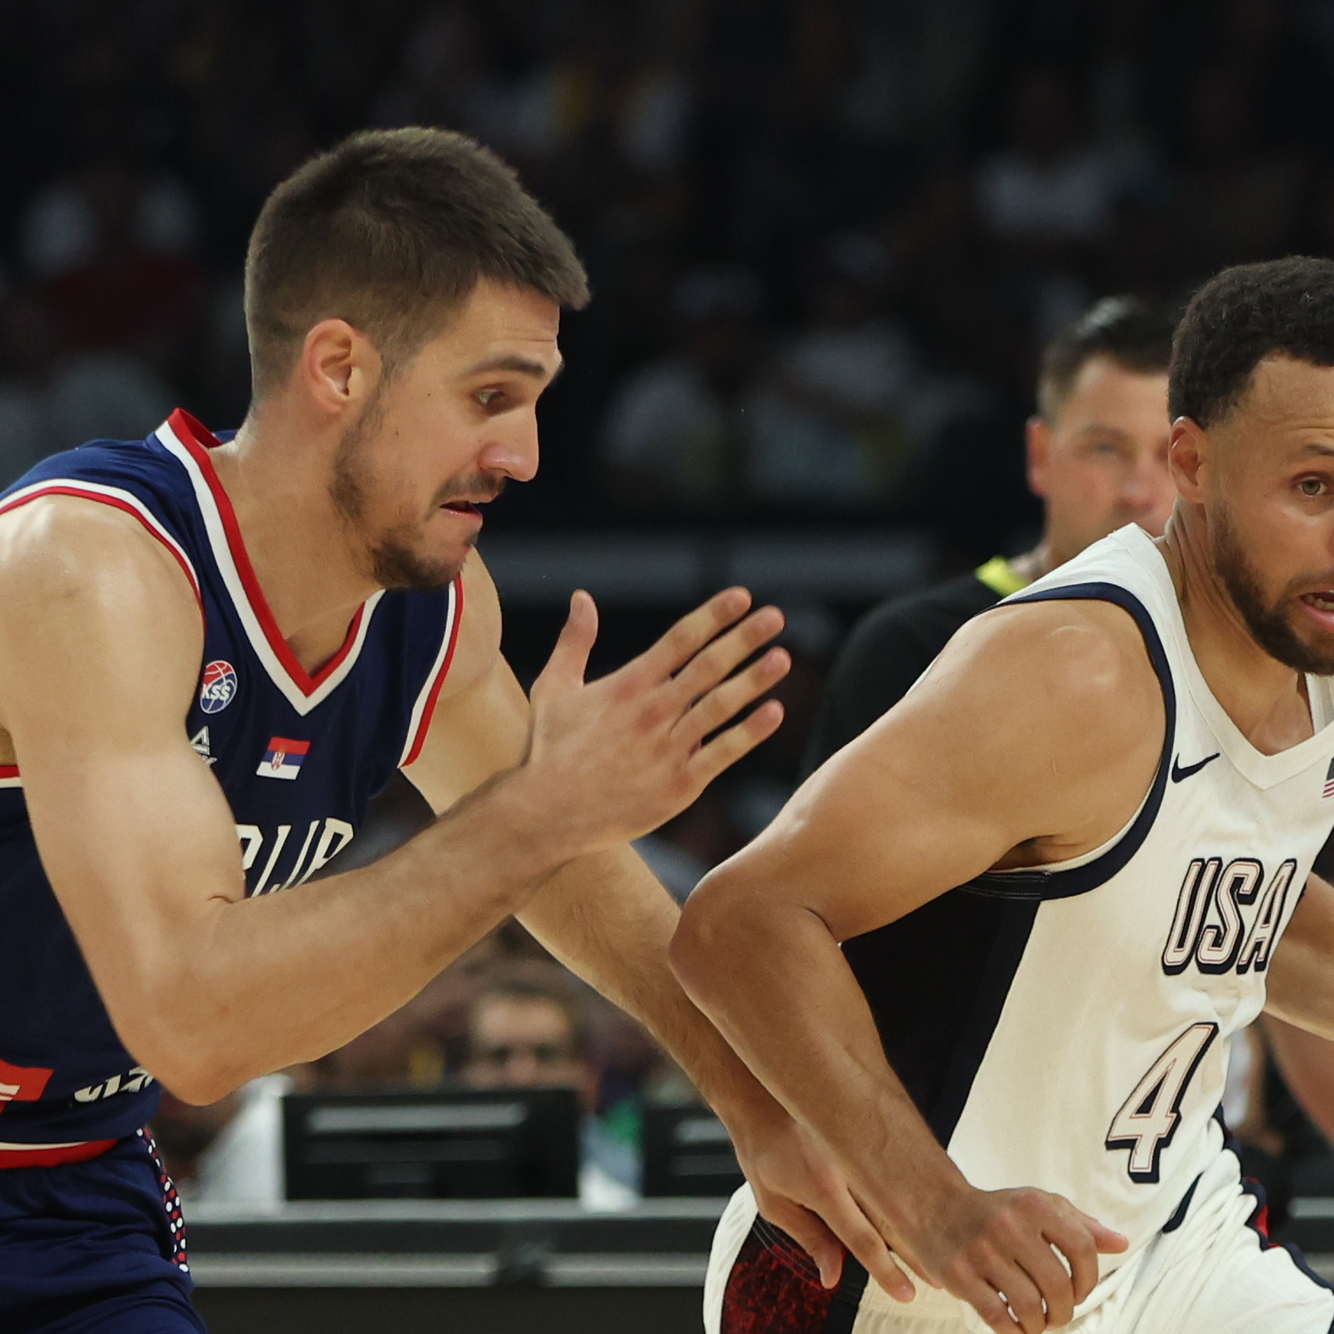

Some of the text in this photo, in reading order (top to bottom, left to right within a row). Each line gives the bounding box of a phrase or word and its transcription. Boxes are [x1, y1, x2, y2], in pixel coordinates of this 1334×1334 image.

[201, 682, 231, 701] KSS
[1161, 857, 1298, 976] USA
[1105, 1021, 1220, 1185] 4
